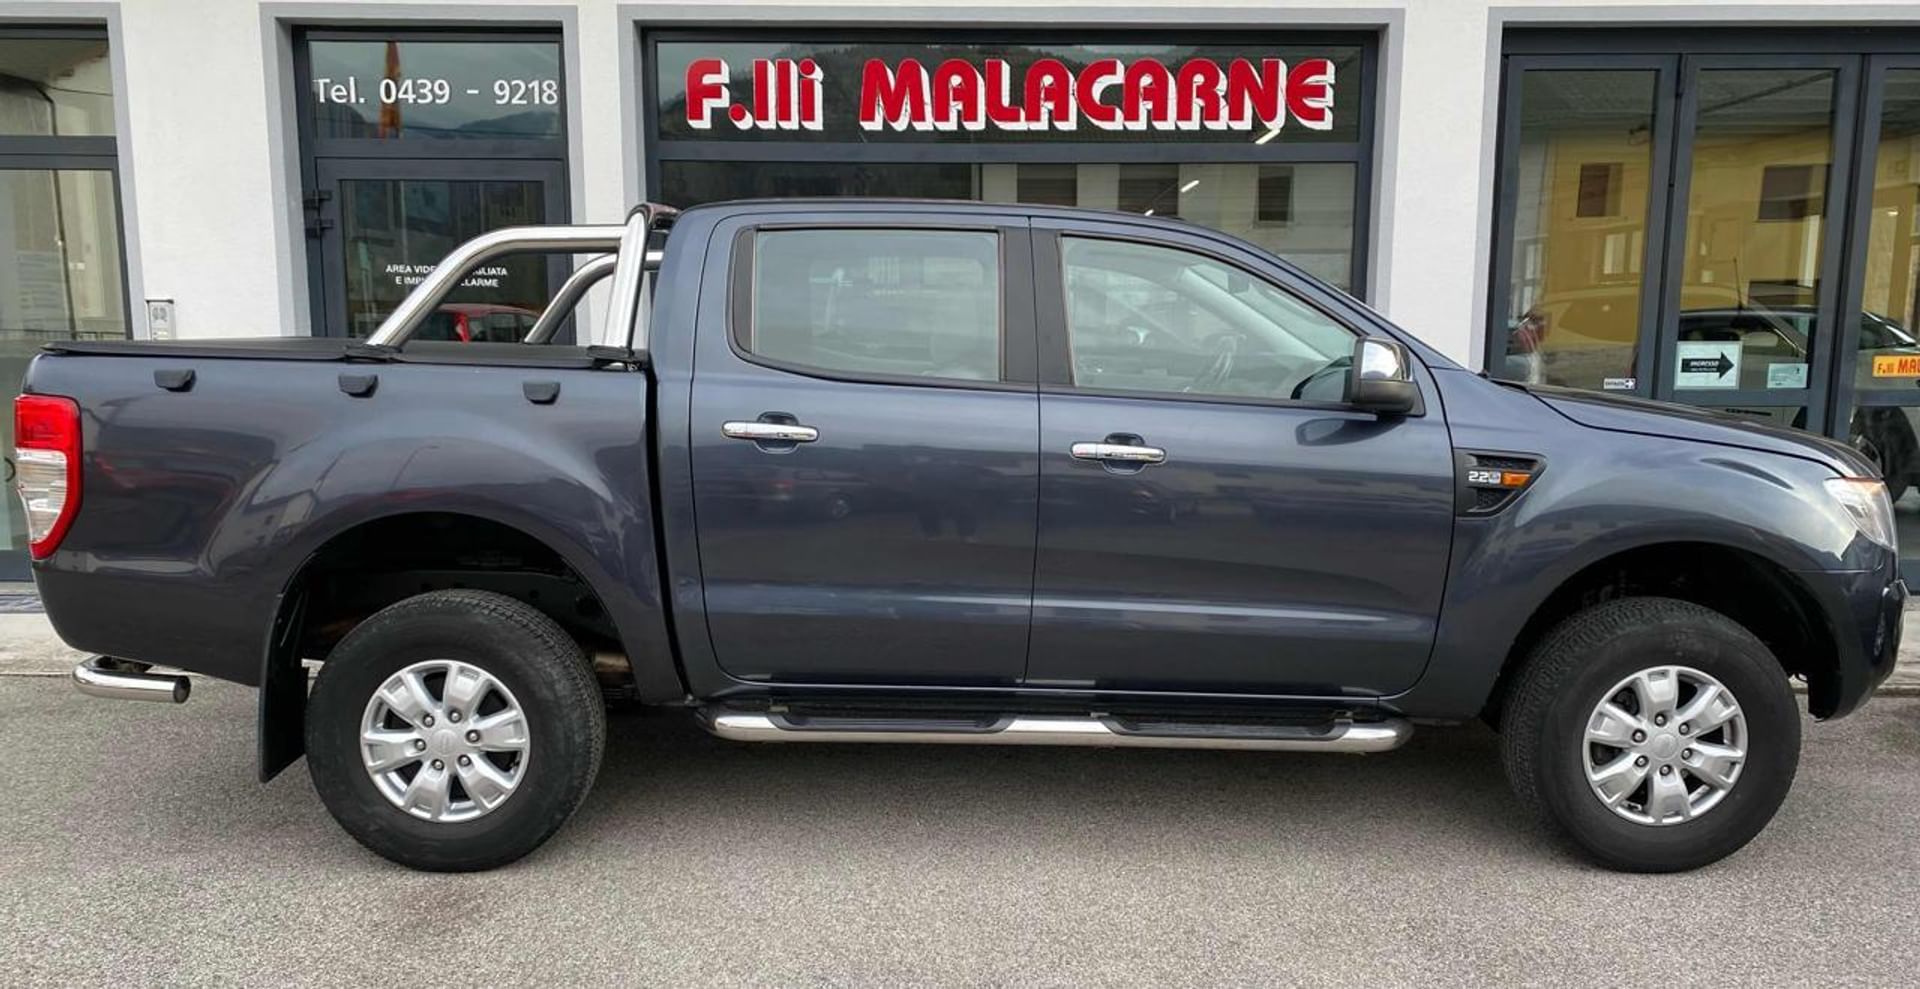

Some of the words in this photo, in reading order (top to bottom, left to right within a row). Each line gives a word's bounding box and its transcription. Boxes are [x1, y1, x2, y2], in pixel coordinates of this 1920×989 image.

[313, 76, 366, 104] Tel.
[379, 78, 450, 105] 0439
[493, 79, 558, 105] 9218
[686, 58, 824, 130] F.lli
[859, 57, 1335, 131] MALACARNE
[385, 264, 412, 273] AREA
[395, 275, 403, 285] E
